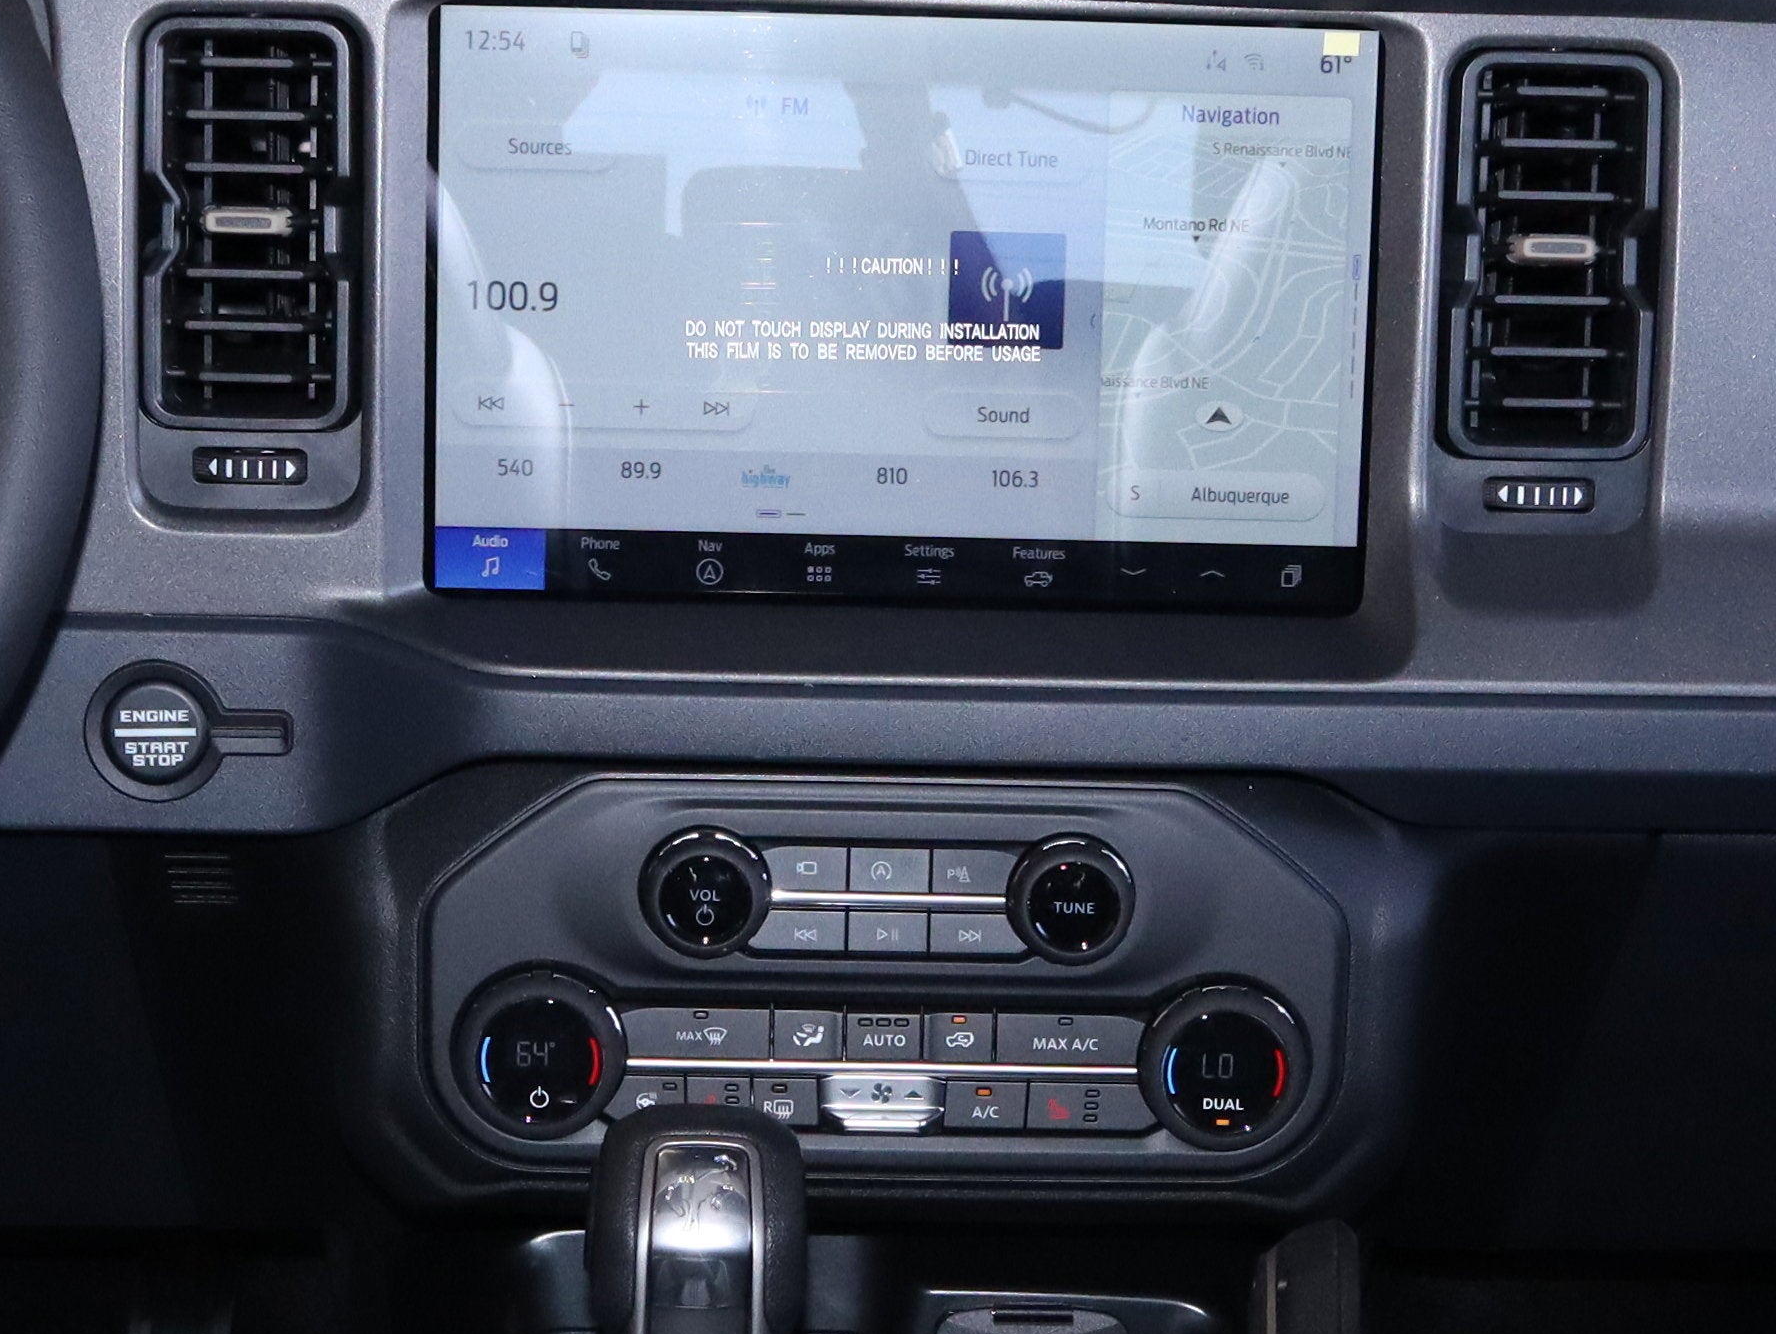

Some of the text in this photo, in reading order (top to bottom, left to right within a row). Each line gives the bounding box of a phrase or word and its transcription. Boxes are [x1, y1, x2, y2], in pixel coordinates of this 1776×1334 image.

[465, 30, 525, 51] 12:54
[782, 97, 809, 116] FM
[1182, 104, 1280, 127] Navigation
[508, 137, 572, 156] Sources
[1213, 142, 1221, 155] S
[1223, 142, 1303, 158] Renaissance
[1306, 145, 1333, 159] Blvd
[965, 149, 1058, 168] Direct Tune
[1143, 216, 1250, 234] Montano Rd NE
[468, 281, 558, 311] 100.9
[685, 320, 1040, 341] DO NOT TOUCH DISPLAY DURING INSTALLATION
[686, 342, 1041, 362] THIS FILM IS TO BE REMOVED BEFORE USAGE
[1160, 375, 1210, 390] Blvd NE
[977, 406, 1031, 424] Sound
[497, 459, 533, 477] 540
[620, 461, 662, 480] 89.9
[876, 467, 908, 486] 810
[741, 470, 791, 489] highway
[991, 469, 1039, 488] 106.3
[1130, 485, 1140, 501] S
[1191, 486, 1290, 506] Albuquerque
[472, 534, 509, 548] Audio
[580, 536, 620, 551] Phone
[698, 539, 723, 553] Nav
[804, 541, 836, 557] Apps
[904, 543, 955, 560] Settings
[1012, 546, 1066, 560] Features
[119, 709, 190, 723] ENGINE
[124, 741, 189, 755] START
[132, 754, 184, 767] STOP
[689, 889, 721, 903] VOL
[1053, 900, 1096, 915] TUNE
[676, 1030, 702, 1042] MAX
[862, 1032, 907, 1047] AUTO
[1032, 1037, 1099, 1052] MAX A/C
[516, 1041, 556, 1067] 64°
[763, 1100, 773, 1114] R
[971, 1105, 1000, 1119] A/C
[1202, 1097, 1244, 1111] DUAL
